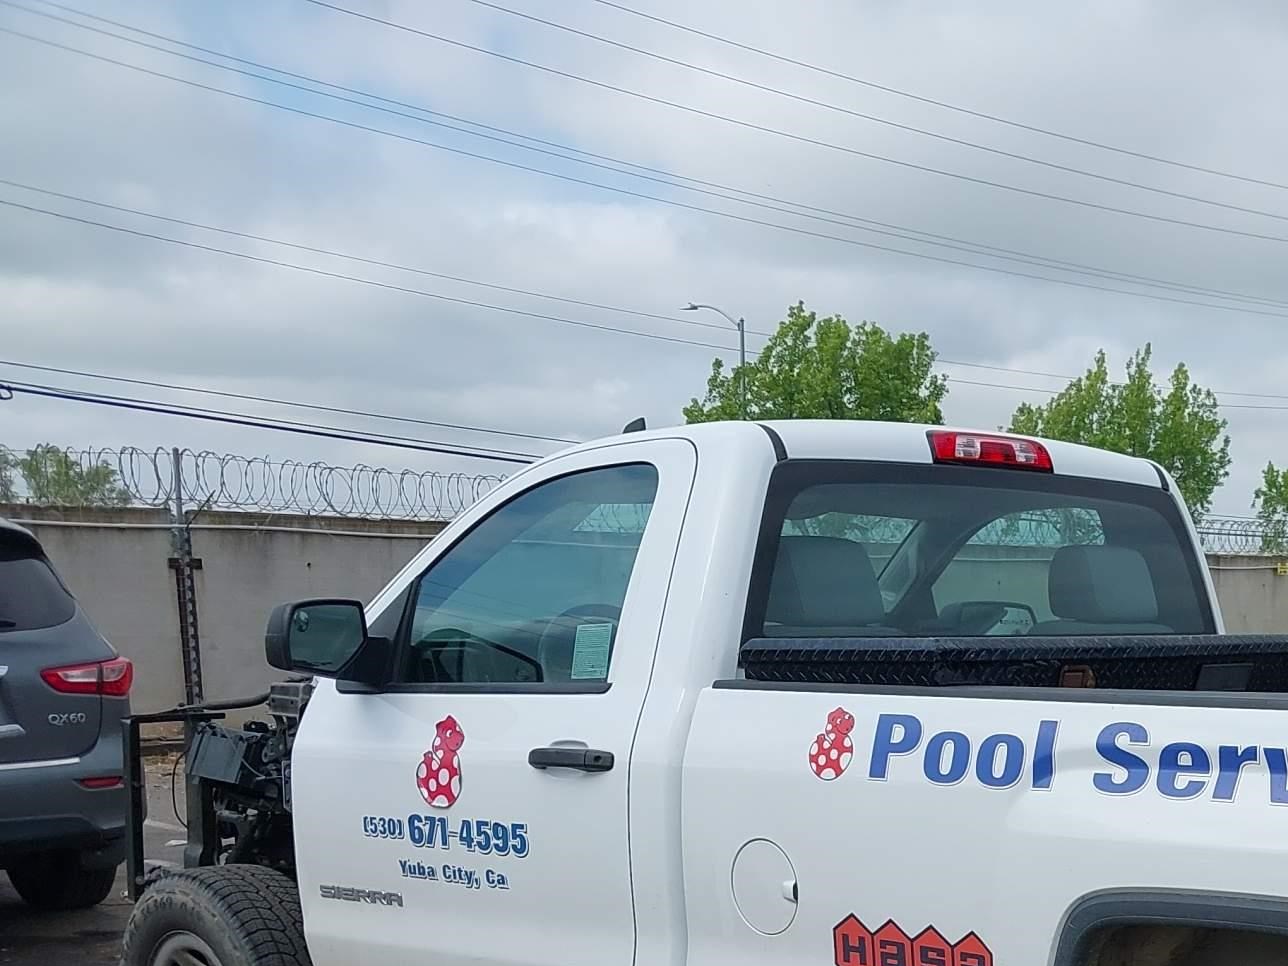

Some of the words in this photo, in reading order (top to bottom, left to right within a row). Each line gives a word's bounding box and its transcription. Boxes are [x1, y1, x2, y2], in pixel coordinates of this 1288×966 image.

[48, 712, 87, 726] QX60
[866, 713, 1062, 792] Pool
[362, 815, 405, 839] (530)
[407, 813, 530, 859] 671-4595
[399, 858, 438, 880] Yuba
[442, 863, 482, 890] City,
[485, 868, 510, 890] Ca
[319, 884, 405, 908] SIERRA
